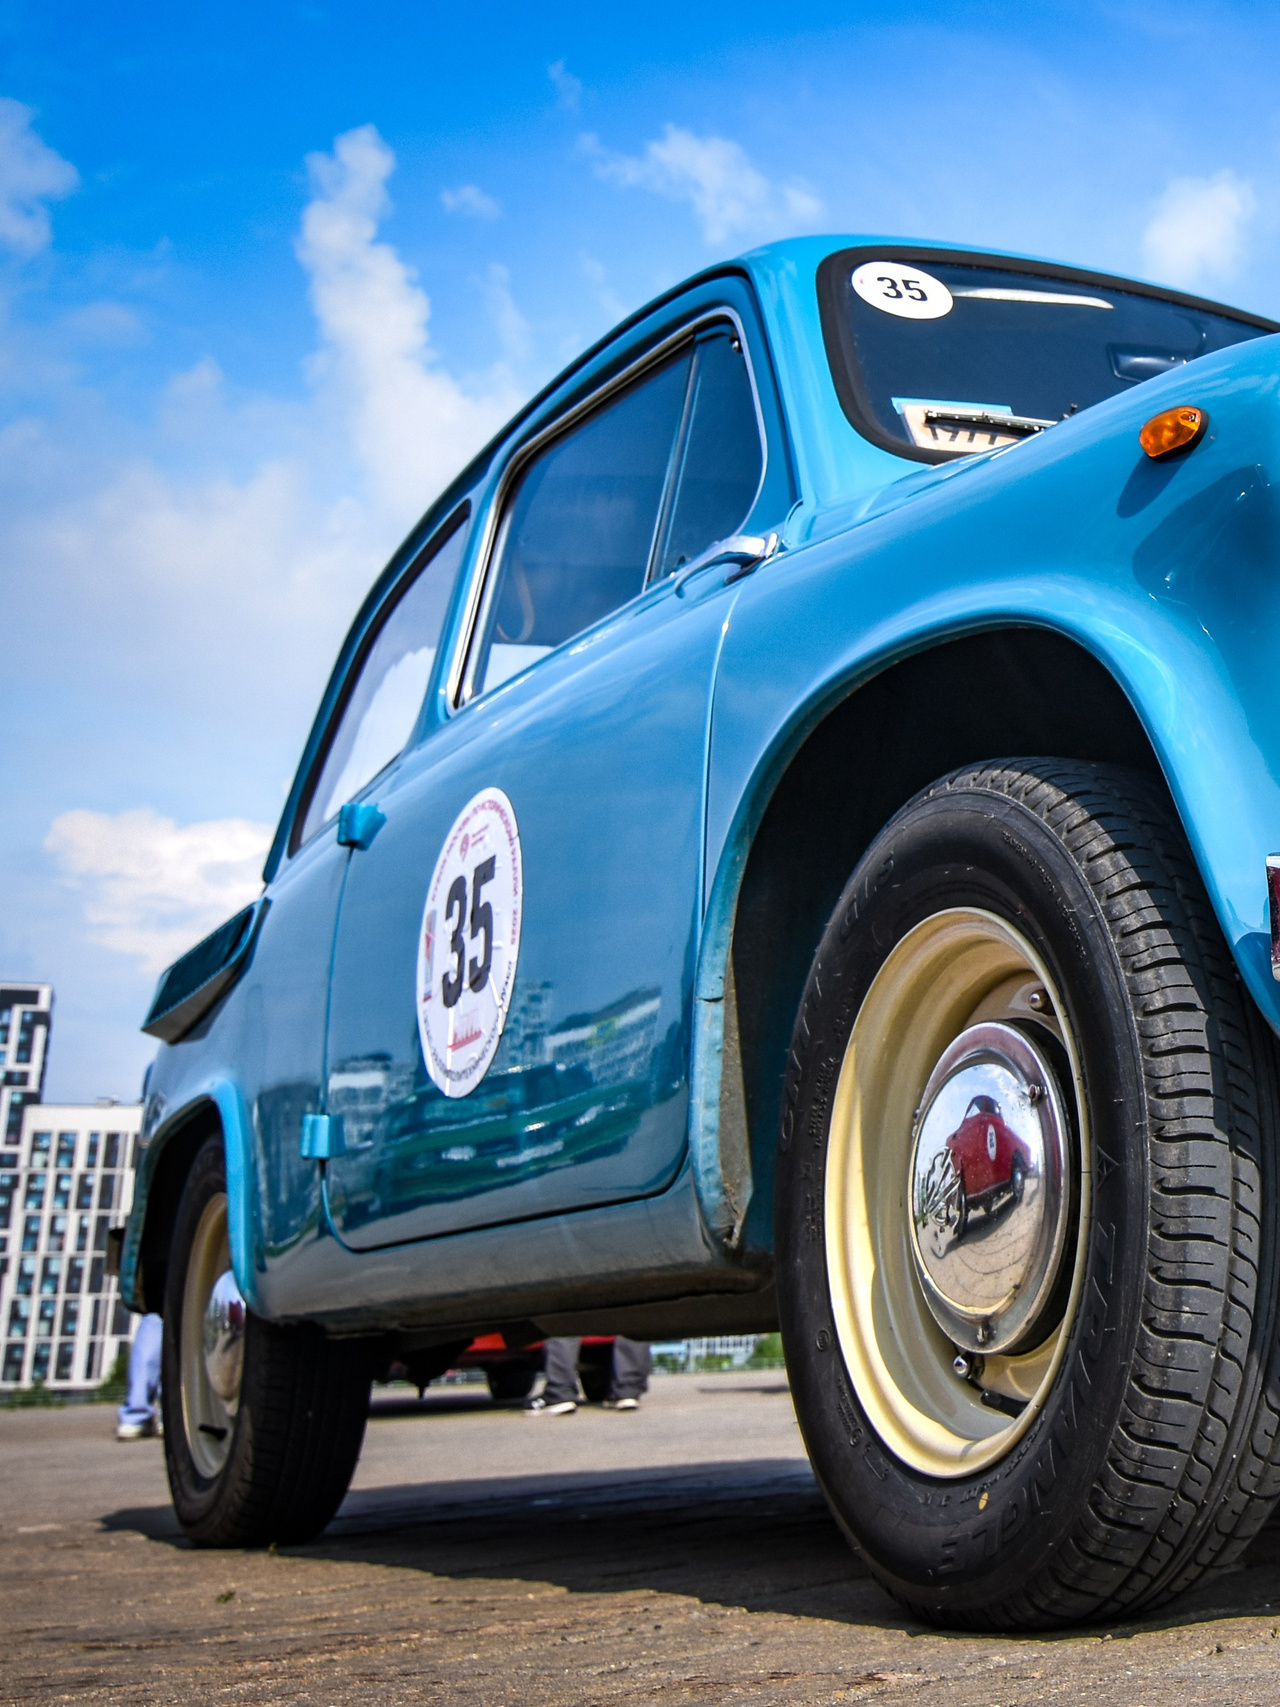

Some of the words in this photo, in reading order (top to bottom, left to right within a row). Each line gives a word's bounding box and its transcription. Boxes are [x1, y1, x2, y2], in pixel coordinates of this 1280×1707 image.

[876, 276, 927, 302] 35
[441, 855, 495, 1009] 35
[937, 1221, 1117, 1575] TRIANGLE
